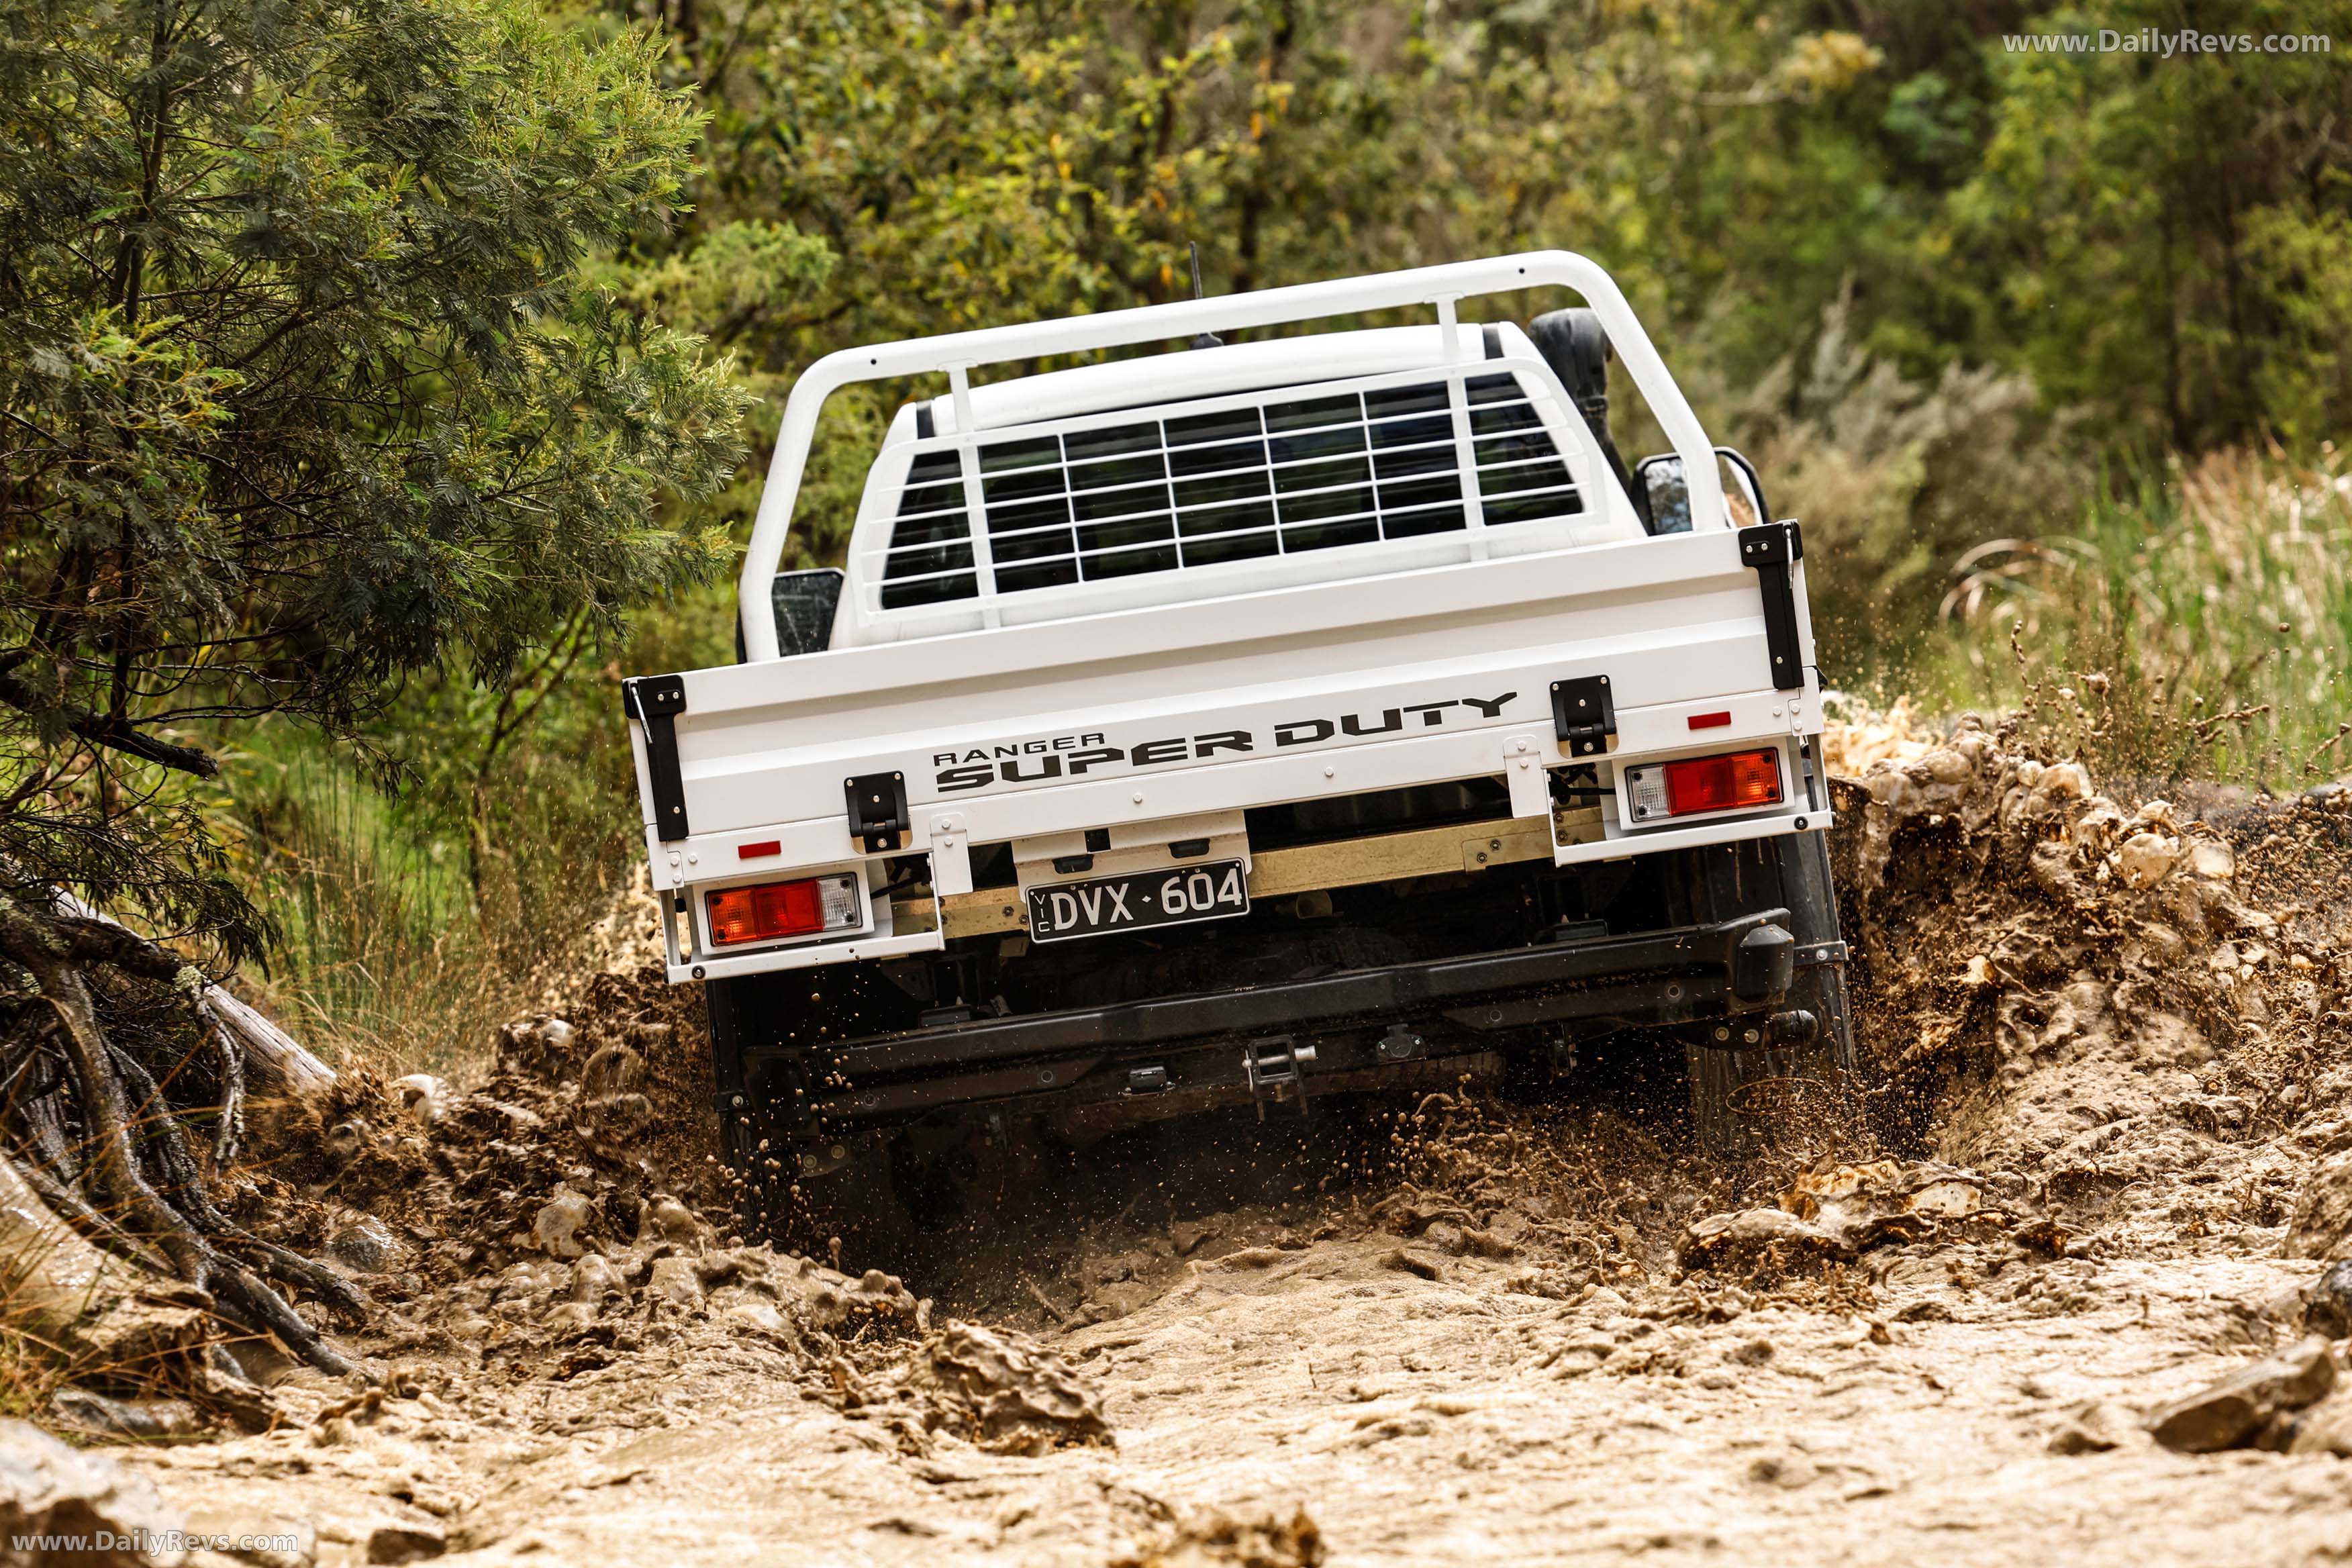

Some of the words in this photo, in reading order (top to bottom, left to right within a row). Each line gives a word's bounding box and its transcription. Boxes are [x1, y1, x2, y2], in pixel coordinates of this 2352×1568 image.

[934, 733, 1105, 767] RANGER
[936, 730, 1254, 793] SUPER
[1274, 691, 1517, 747] DUTY
[1034, 894, 1050, 932] VIC
[1050, 883, 1134, 931] DVX
[1161, 868, 1242, 914] 604
